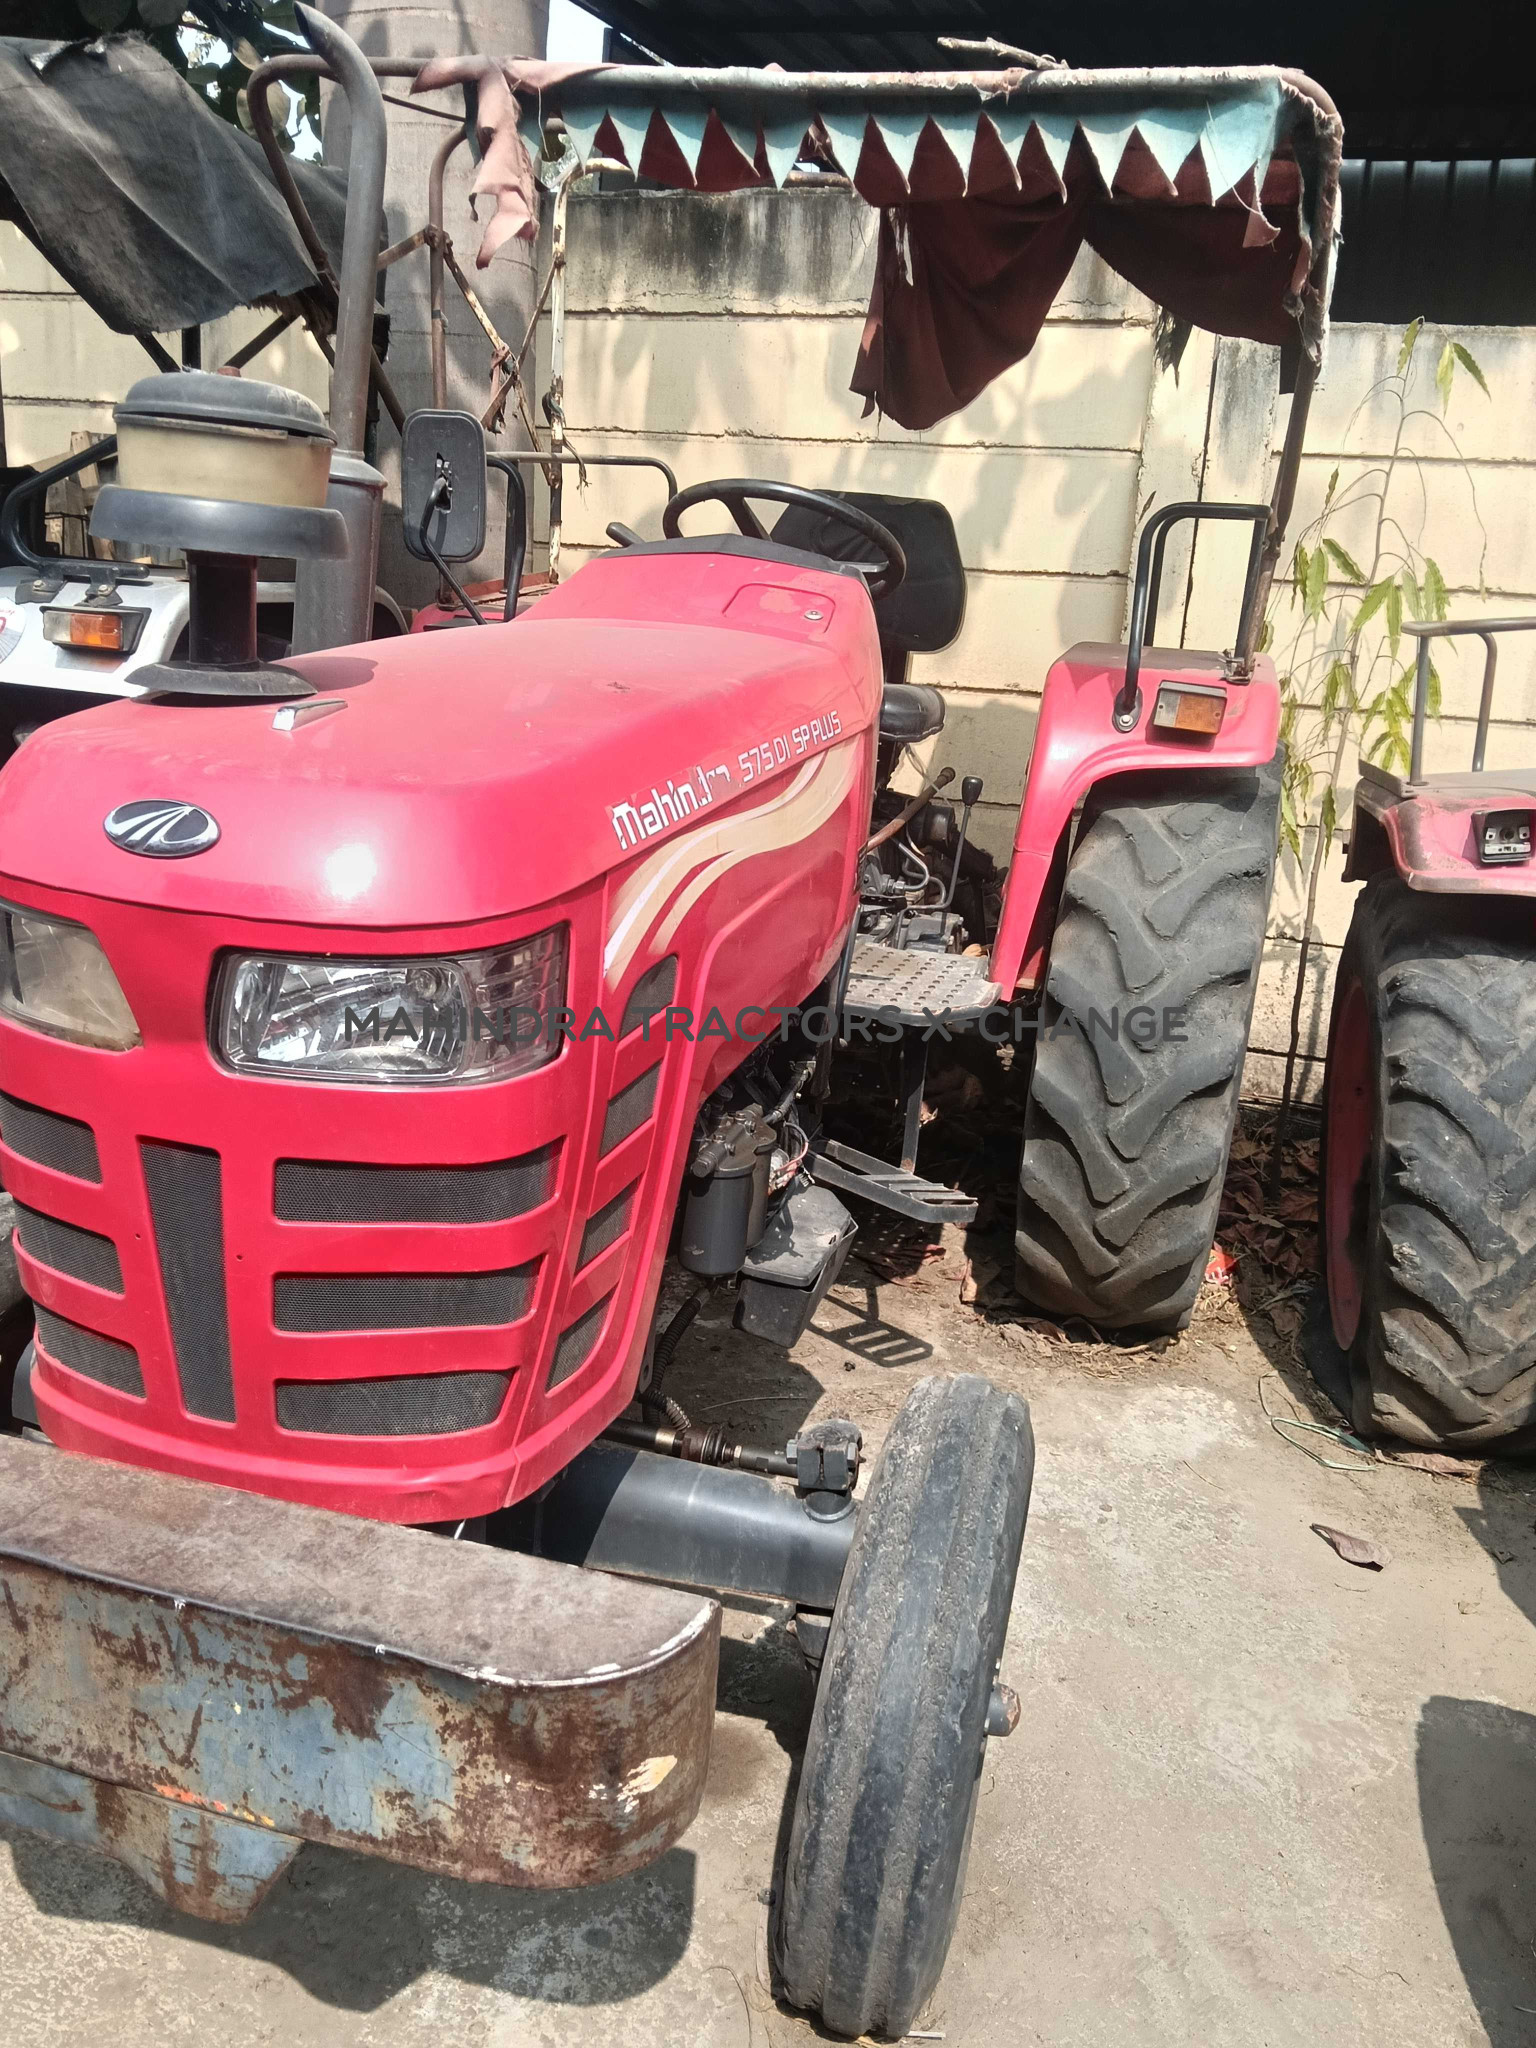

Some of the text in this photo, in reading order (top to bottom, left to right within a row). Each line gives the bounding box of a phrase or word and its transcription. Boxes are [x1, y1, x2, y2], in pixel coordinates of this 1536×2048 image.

[738, 742, 775, 783] 575
[773, 734, 791, 765] DI
[791, 724, 811, 755] SP
[810, 710, 842, 745] PLUS
